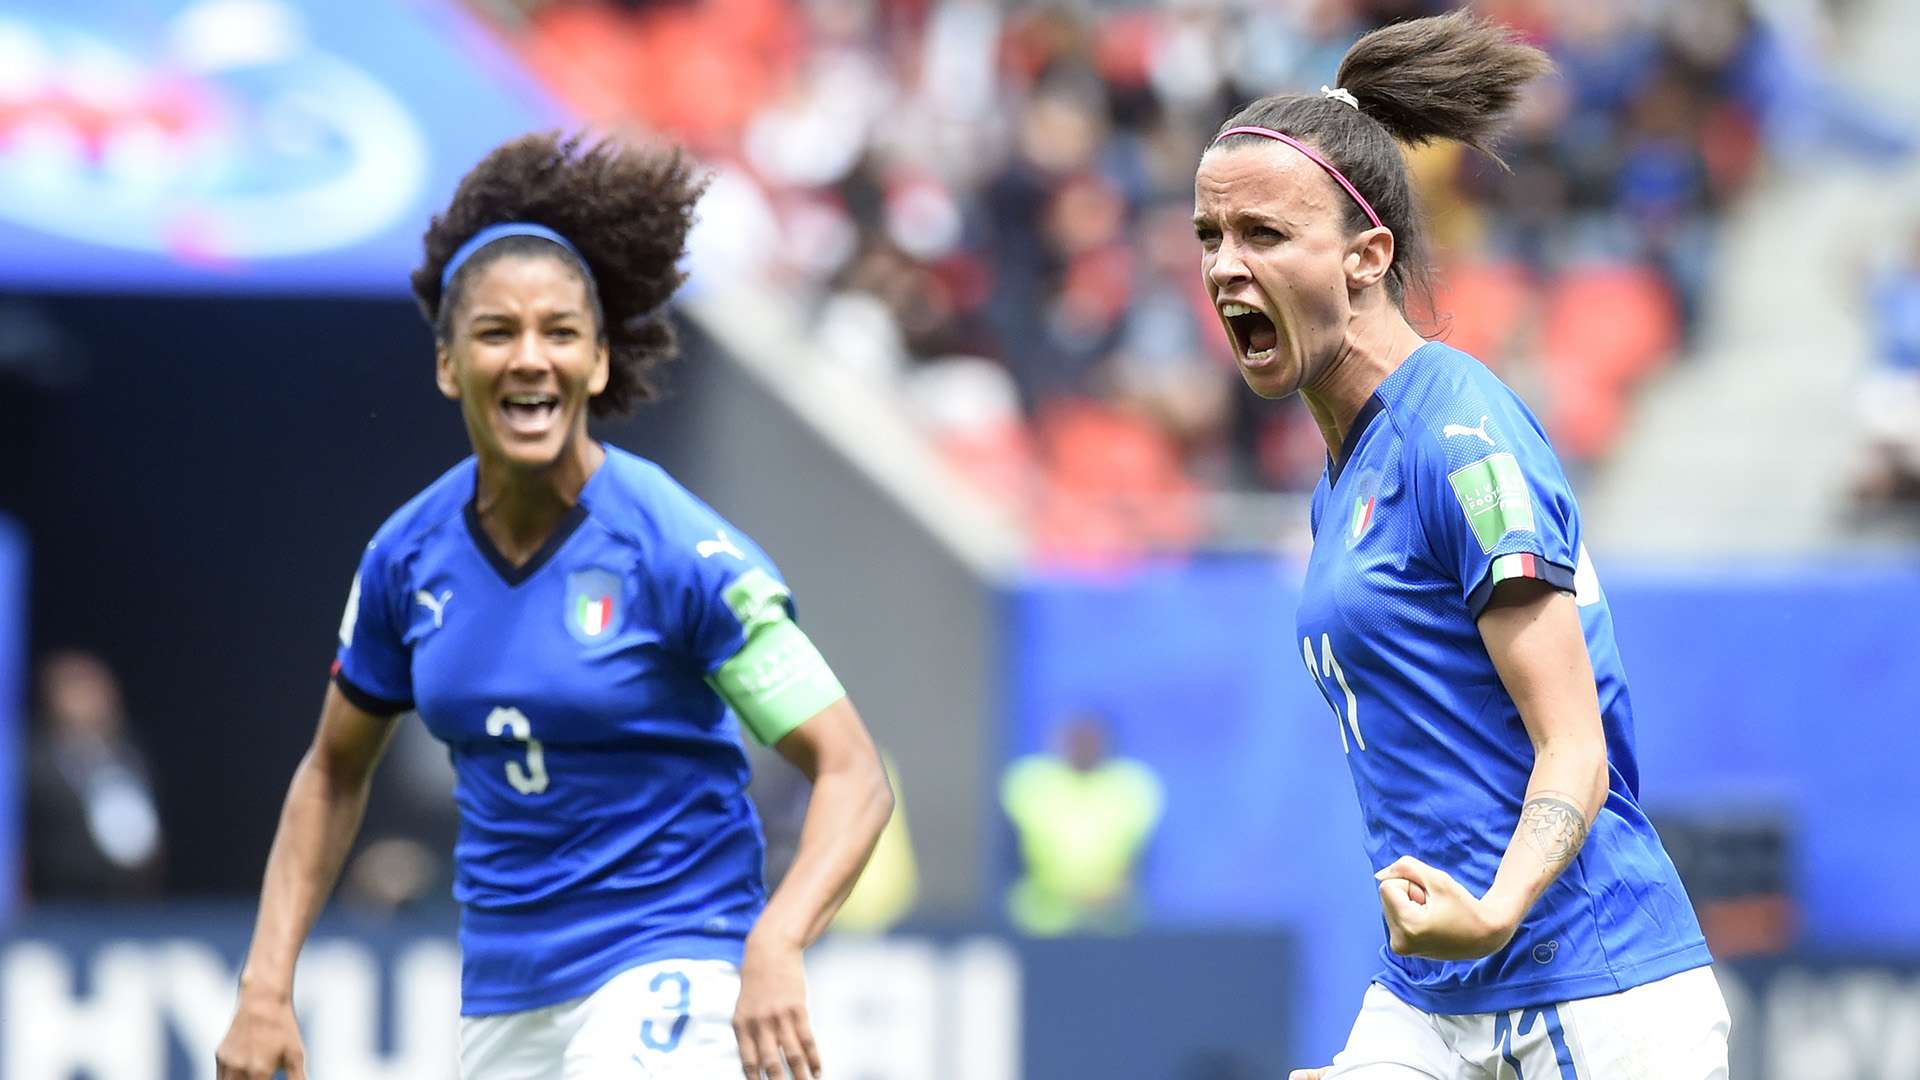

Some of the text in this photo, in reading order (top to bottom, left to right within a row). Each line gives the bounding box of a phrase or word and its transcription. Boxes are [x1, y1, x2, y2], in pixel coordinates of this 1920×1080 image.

[1303, 632, 1366, 754] 11
[486, 706, 550, 795] 3
[640, 970, 690, 1053] 3
